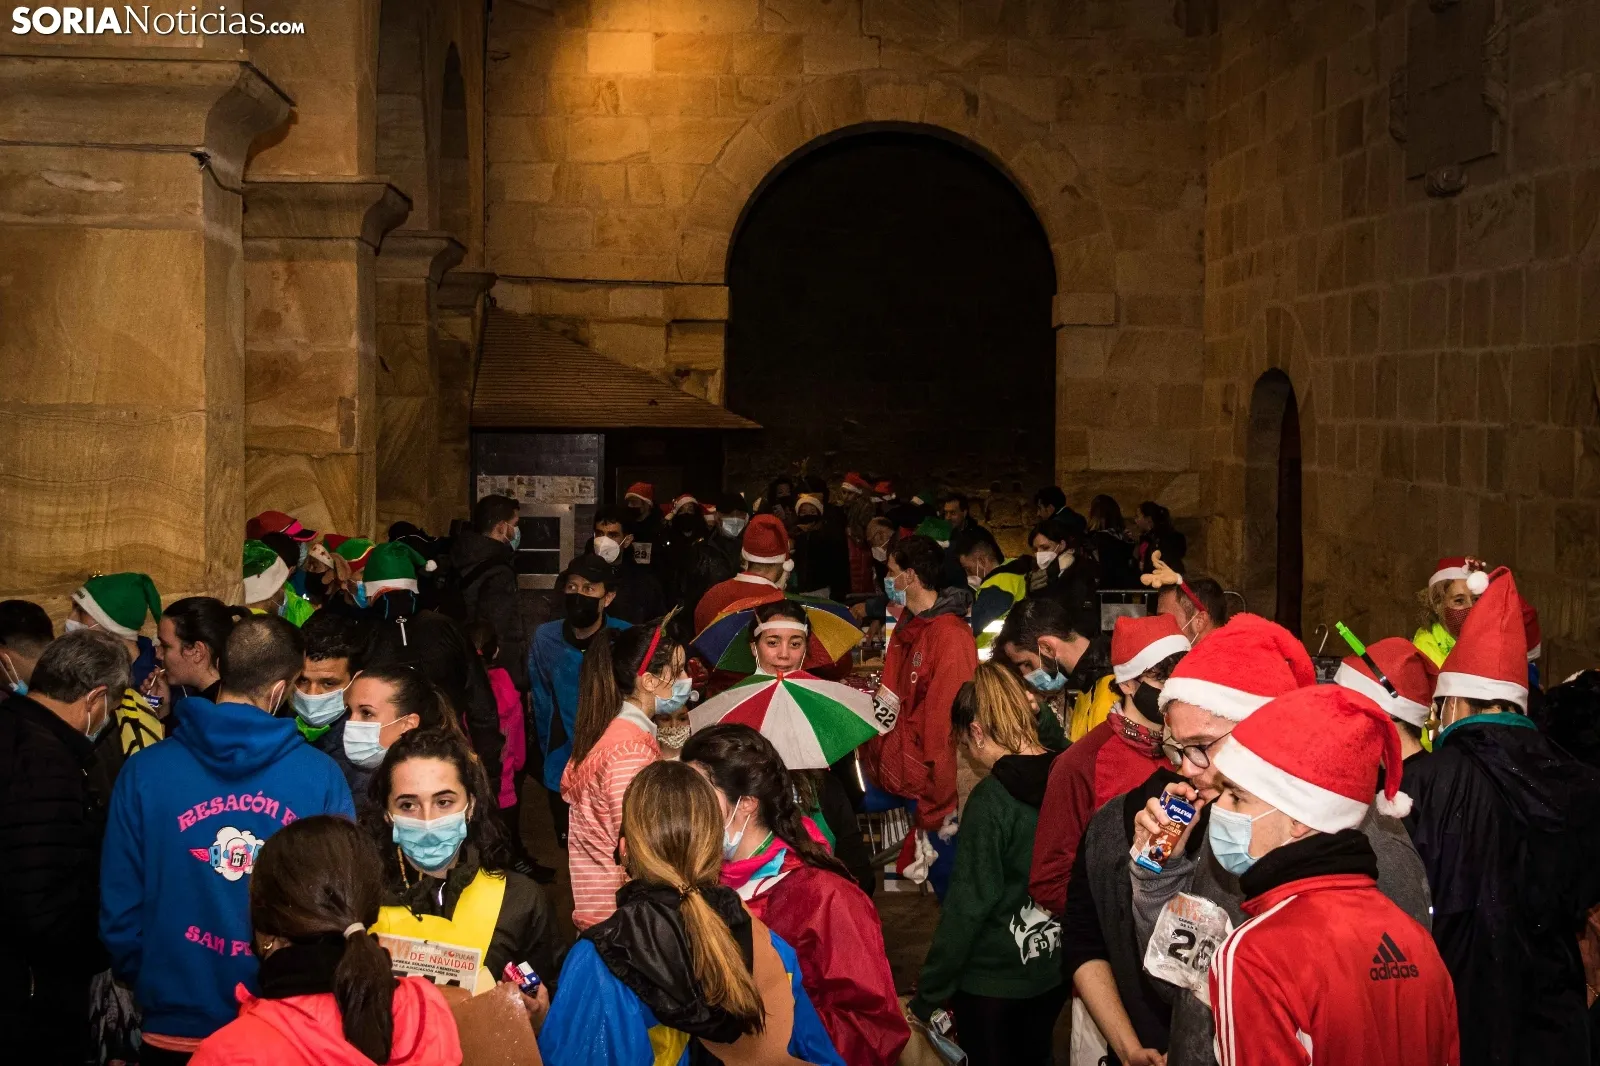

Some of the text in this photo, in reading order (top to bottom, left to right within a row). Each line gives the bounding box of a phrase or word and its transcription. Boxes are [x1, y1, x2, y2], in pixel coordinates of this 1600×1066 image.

[177, 790, 280, 832] RESACÓN
[1169, 804, 1193, 819] PULEVA
[184, 925, 225, 955] SAN
[410, 951, 475, 971] DE NAVIDAD
[1369, 961, 1419, 981] adidas
